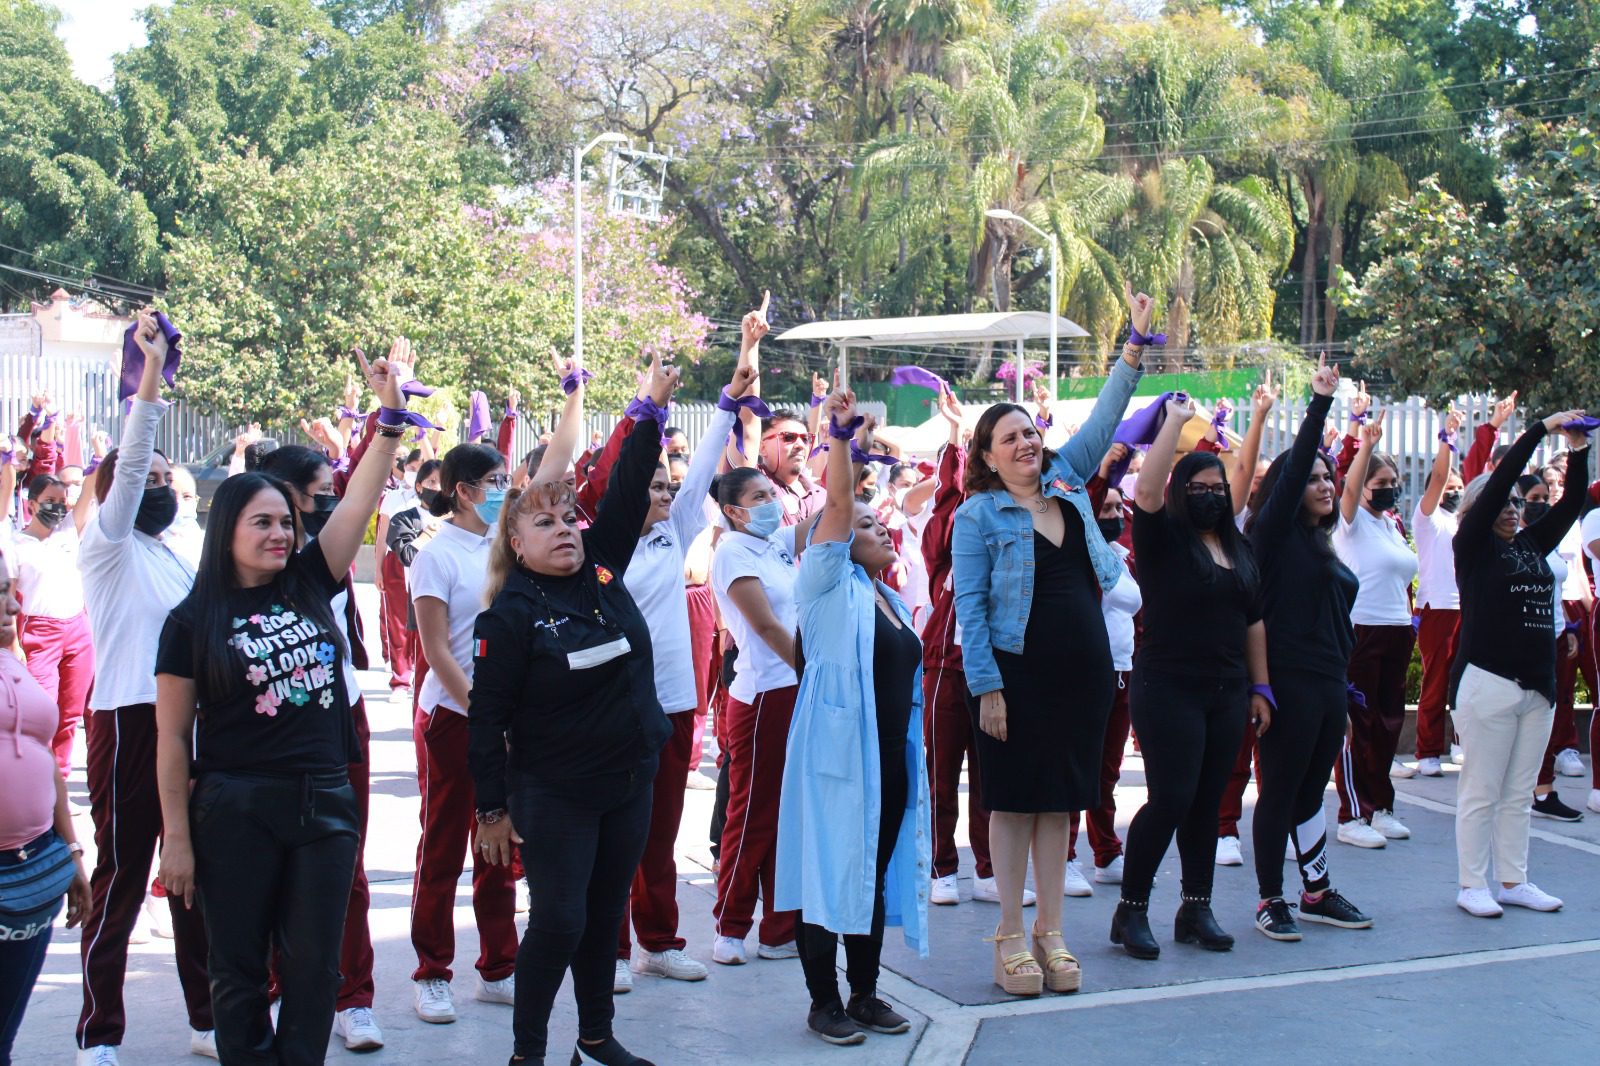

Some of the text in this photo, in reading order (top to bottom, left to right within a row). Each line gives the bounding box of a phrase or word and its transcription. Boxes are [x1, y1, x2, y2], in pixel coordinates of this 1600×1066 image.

[242, 617, 328, 659] OUTSID
[259, 615, 286, 634] GO
[265, 642, 321, 678] LOOK
